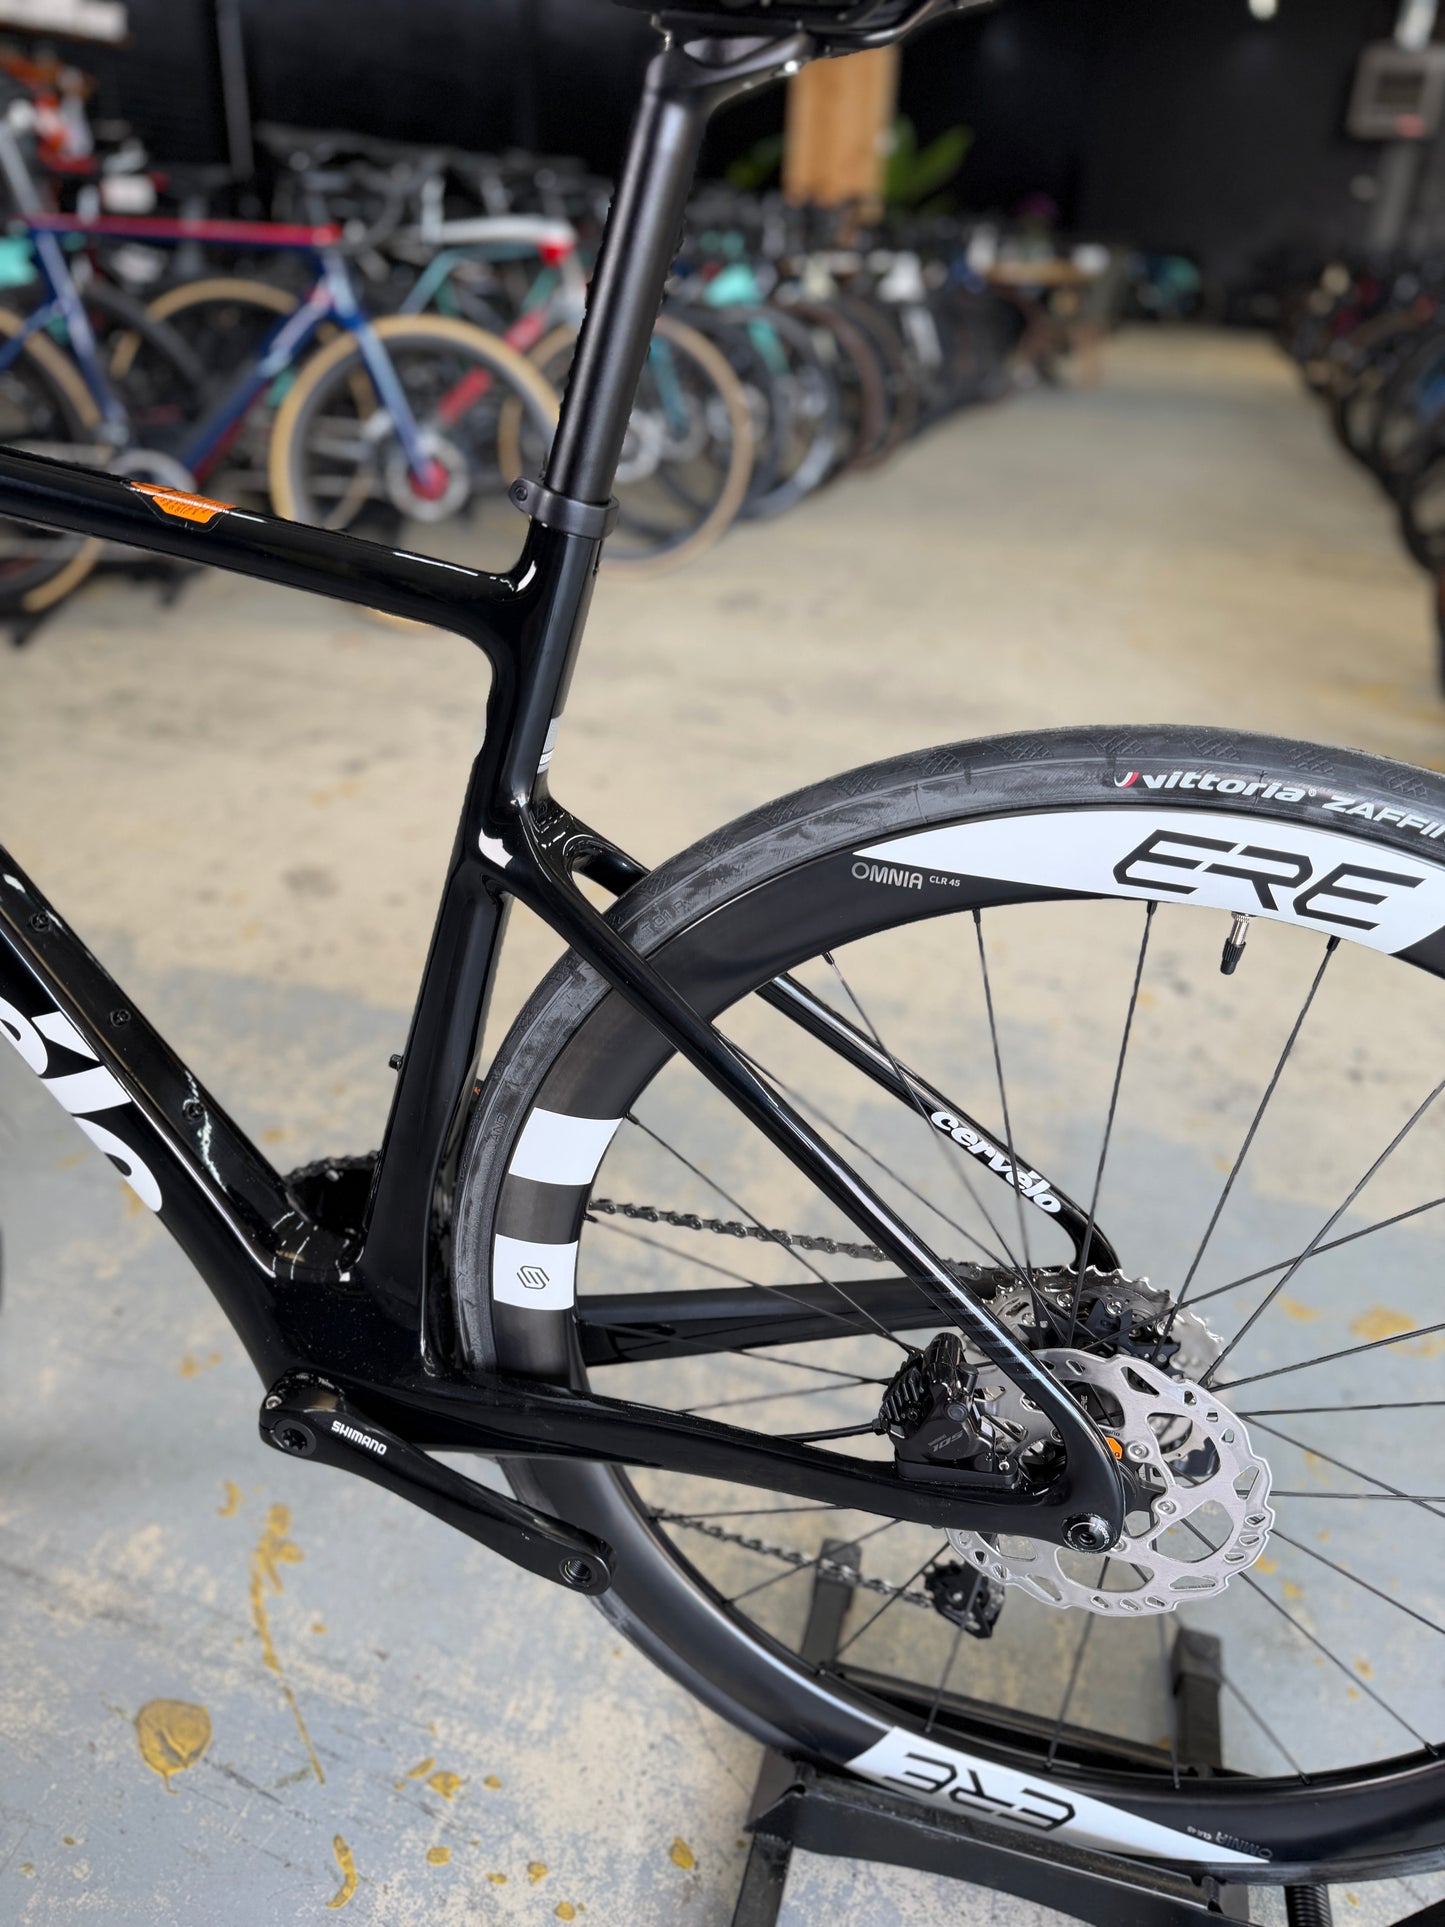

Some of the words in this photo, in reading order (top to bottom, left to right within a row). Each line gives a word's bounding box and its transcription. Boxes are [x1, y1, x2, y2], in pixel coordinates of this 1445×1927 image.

[1322, 795, 1445, 840] ZAFFI
[852, 861, 923, 890] OMNIA
[929, 875, 948, 886] CLR
[948, 879, 961, 887] 45
[1113, 828, 1426, 931] ERE
[331, 1420, 387, 1456] SHIMANO
[882, 1751, 1076, 1831] ERE
